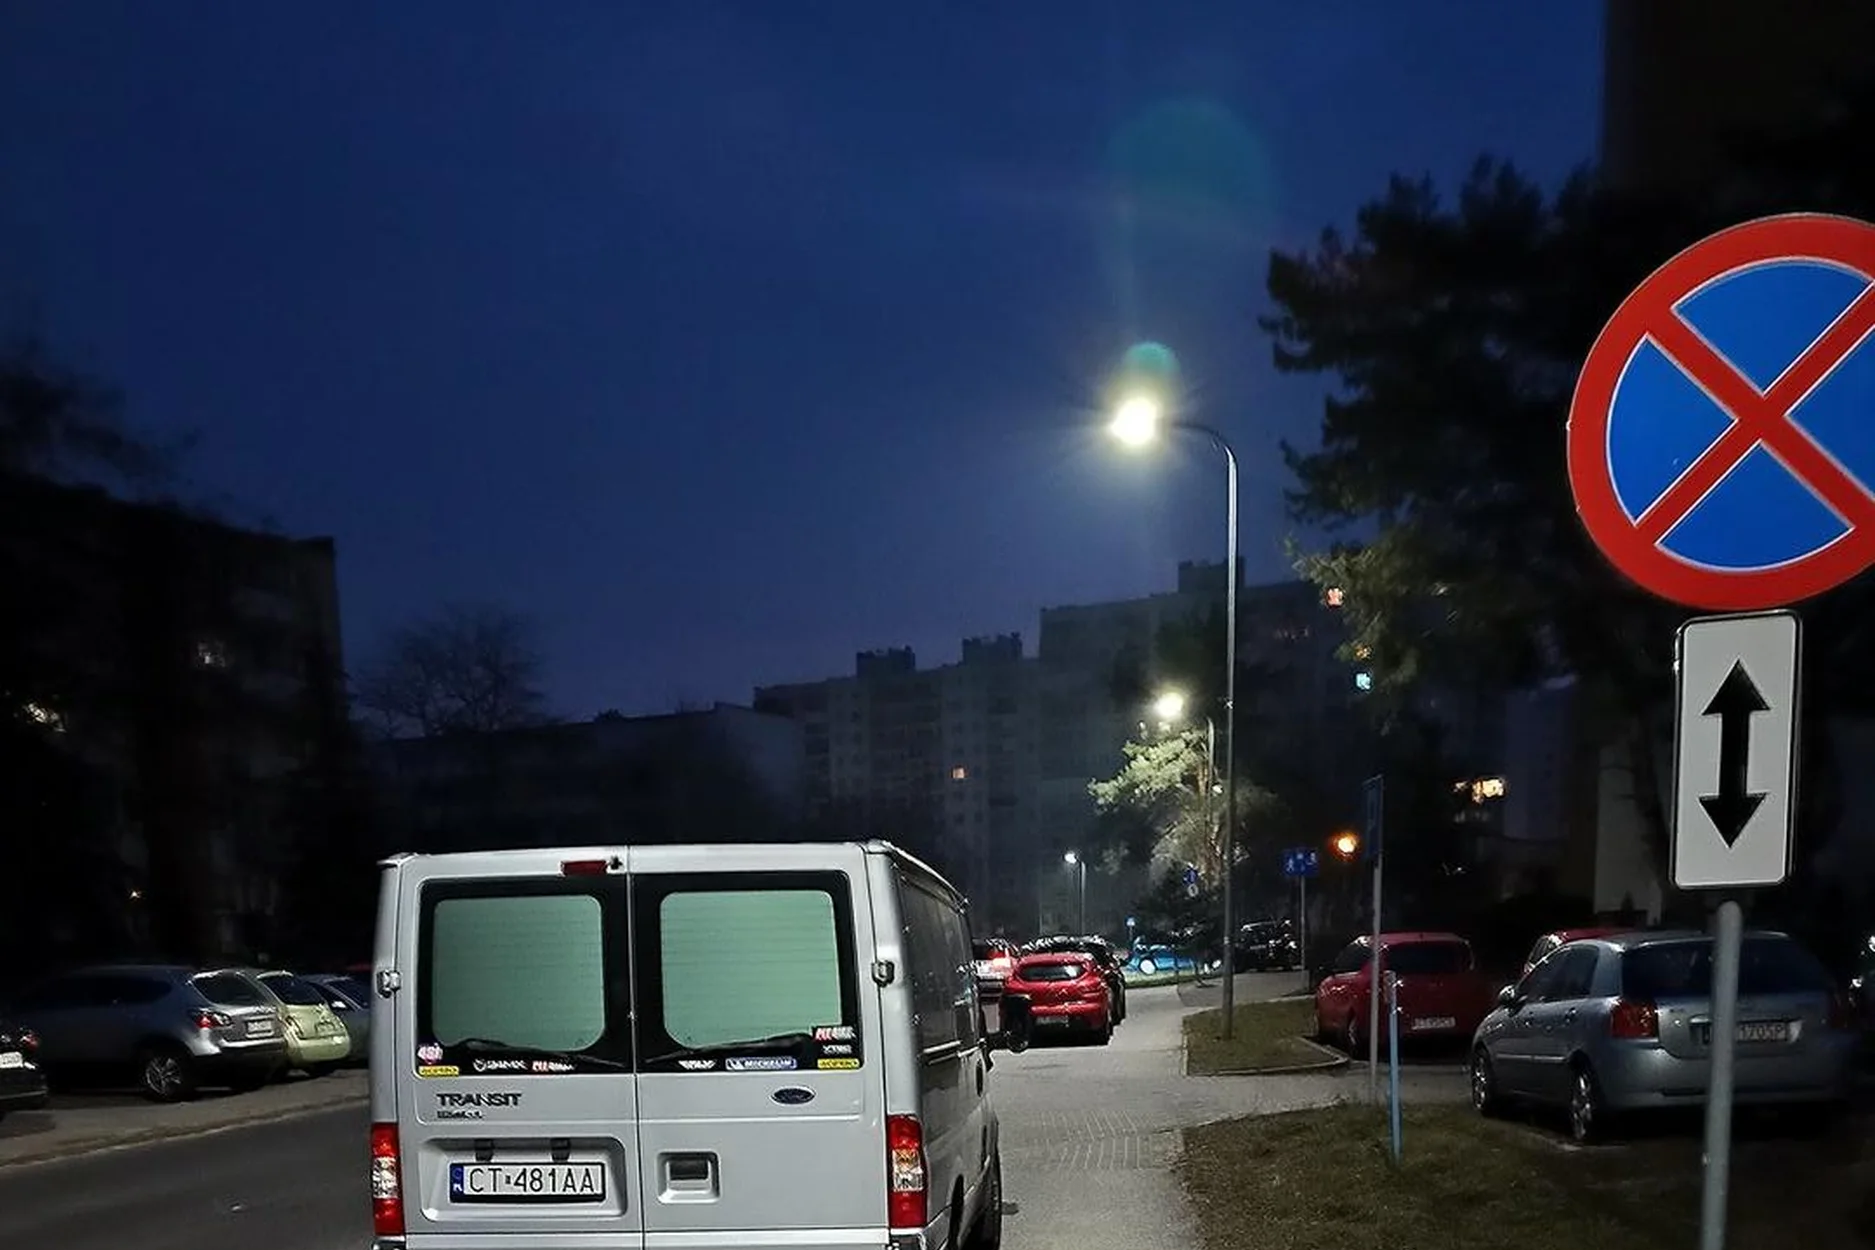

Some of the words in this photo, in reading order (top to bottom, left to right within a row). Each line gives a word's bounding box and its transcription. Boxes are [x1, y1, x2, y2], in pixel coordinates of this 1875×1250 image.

[436, 1092, 522, 1107] TRANSIT
[469, 1167, 502, 1193] CT
[513, 1167, 595, 1193] 481AA
